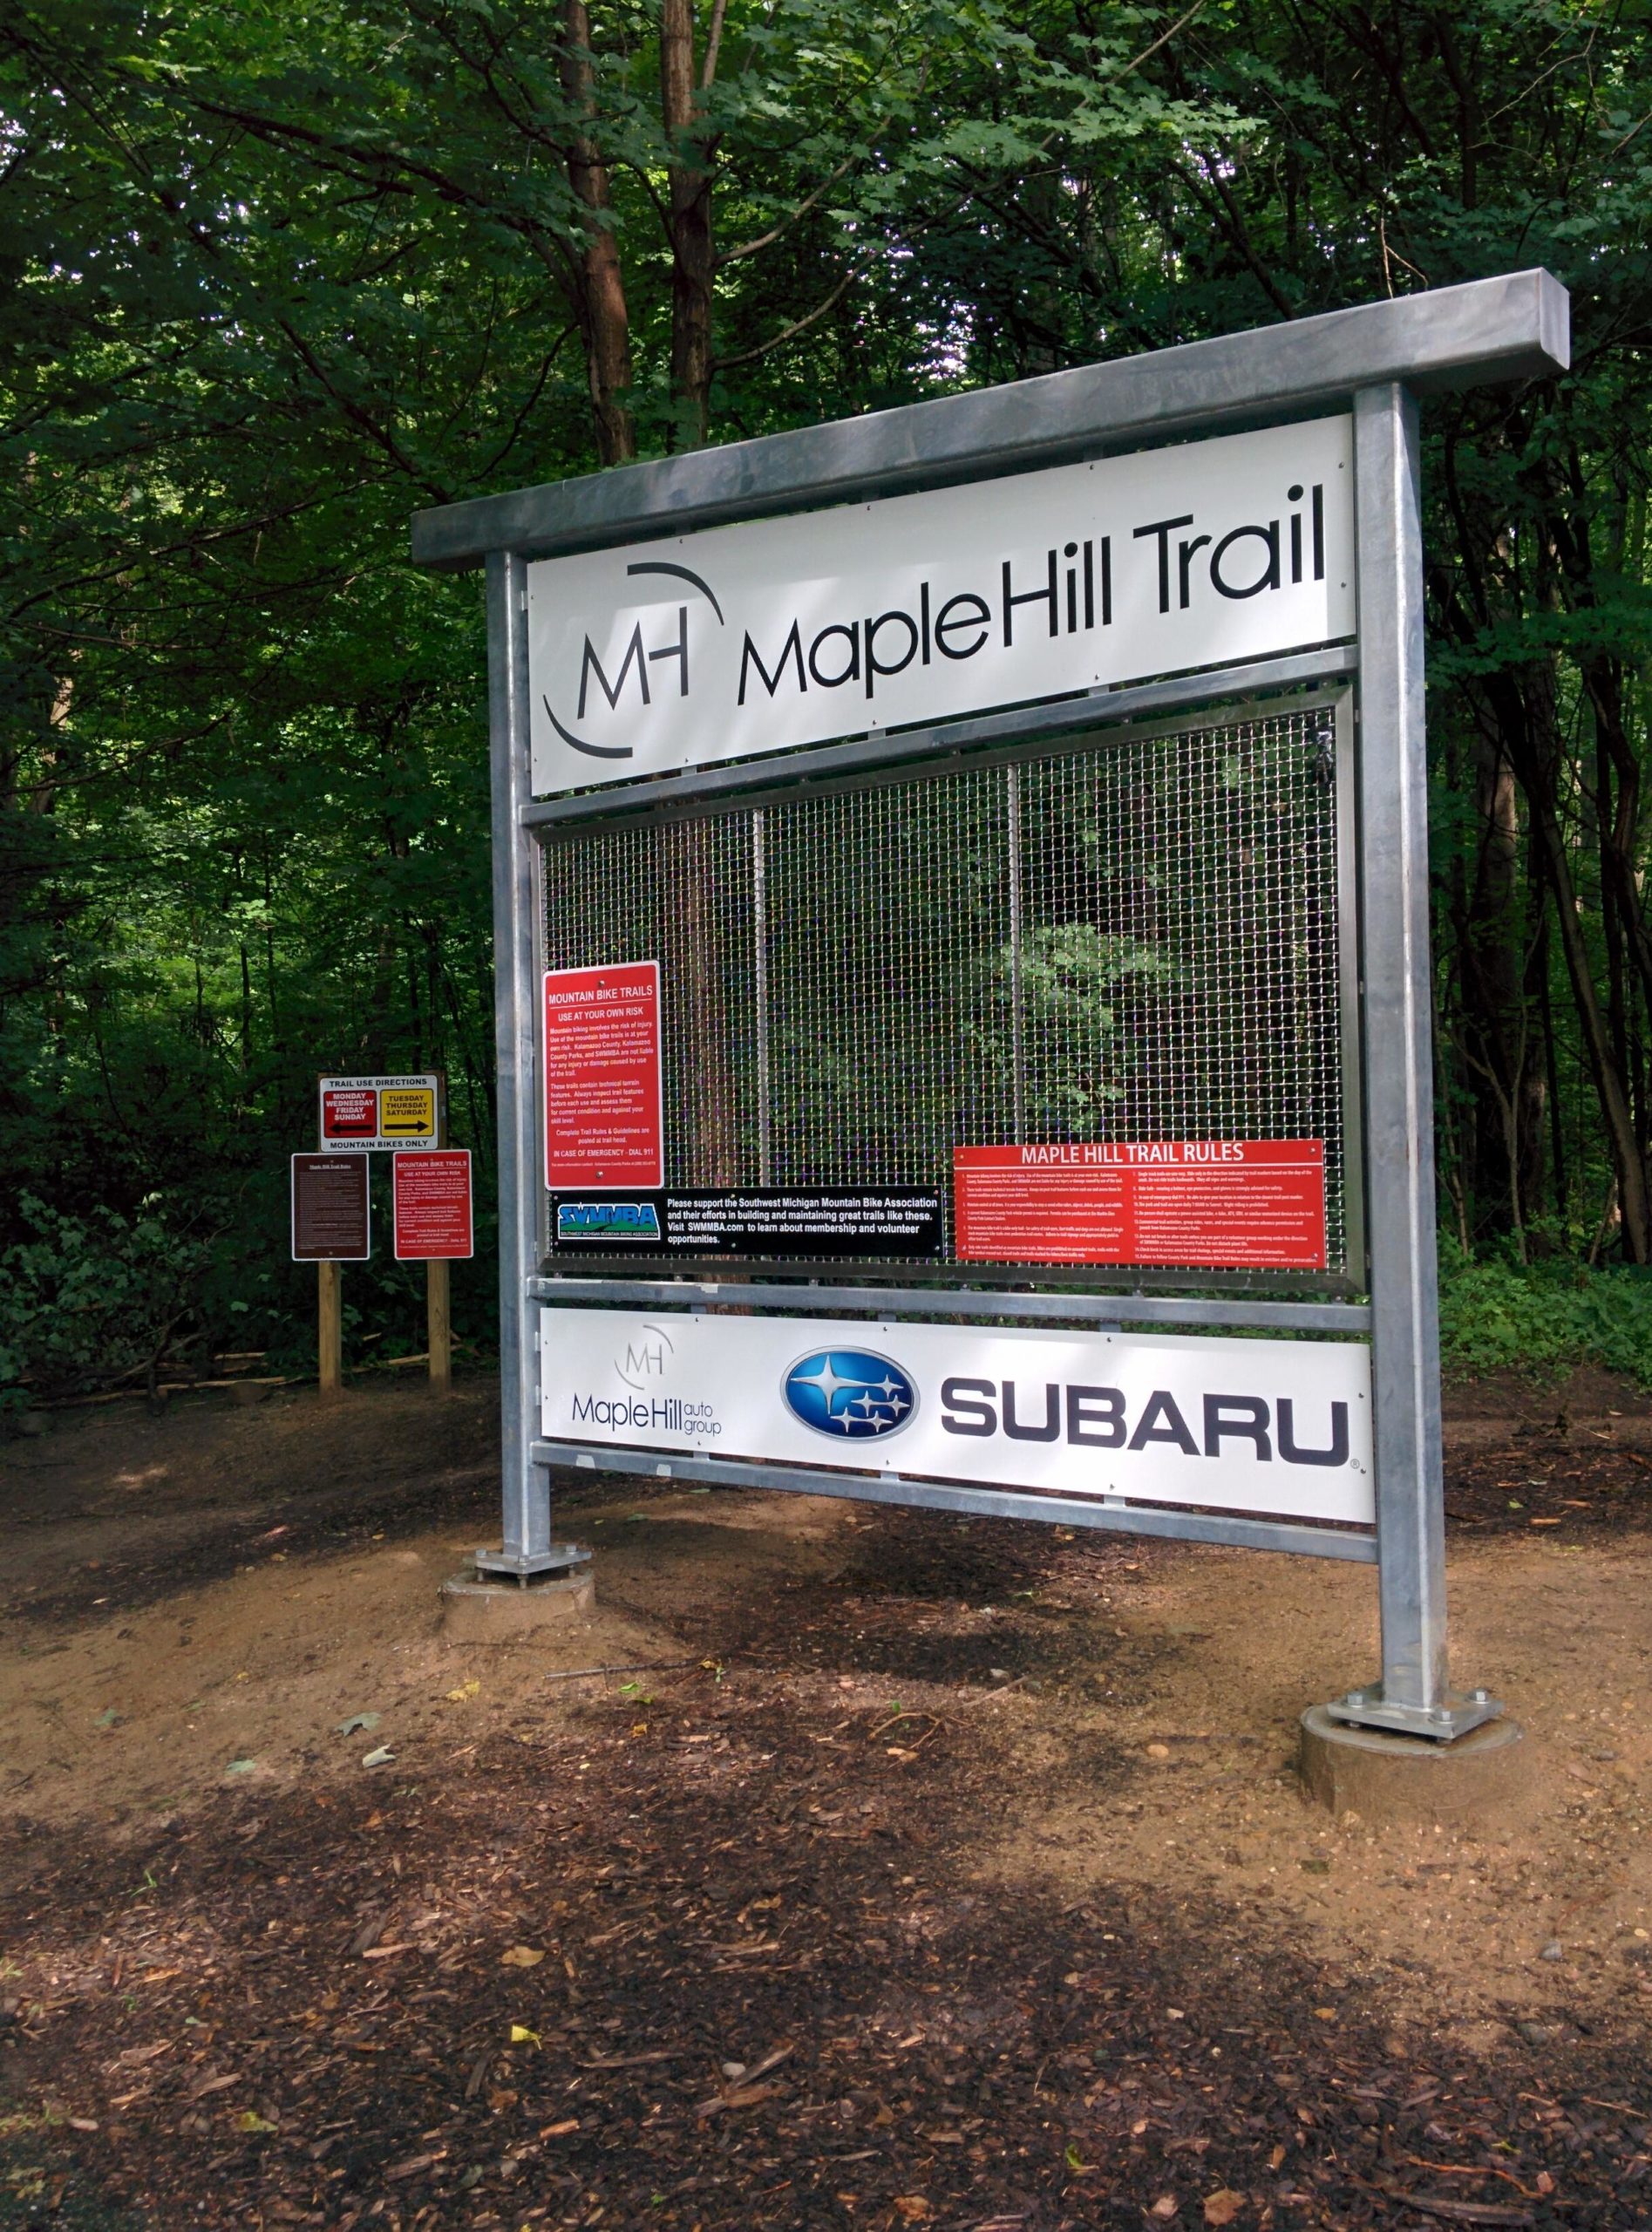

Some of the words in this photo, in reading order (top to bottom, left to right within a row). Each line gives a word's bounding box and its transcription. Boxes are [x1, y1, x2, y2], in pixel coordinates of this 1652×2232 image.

[1133, 484, 1324, 614] Trail
[578, 607, 688, 719] MH
[549, 991, 594, 1004] MOUNTAIN
[596, 989, 617, 1000] BIKE
[620, 985, 652, 997] TRAILS
[558, 1013, 572, 1022] USE
[584, 1011, 605, 1019] YOUR
[607, 1009, 624, 1017] OWN
[626, 1007, 643, 1016] RISK
[1021, 1147, 1079, 1164] MAPLE
[1084, 1146, 1122, 1162] HILL
[1125, 1144, 1178, 1162] TRAIL
[1183, 1143, 1244, 1161] RULES
[668, 1199, 692, 1208] Please
[693, 1199, 723, 1209] support
[738, 1198, 780, 1208] Southwest
[783, 1198, 819, 1208] Michigan
[821, 1198, 860, 1208] Mountain
[863, 1198, 882, 1207] Bike
[884, 1198, 937, 1208] Association
[668, 1211, 682, 1220] and
[683, 1210, 700, 1220] their
[702, 1210, 727, 1220] efforts
[729, 1211, 736, 1220] in
[738, 1210, 769, 1221] building
[772, 1211, 786, 1220] and
[788, 1210, 837, 1222] maintaining
[839, 1211, 860, 1222] great
[863, 1210, 884, 1220] trails
[887, 1210, 902, 1220] like
[905, 1210, 933, 1221] these.
[668, 1222, 684, 1231] Visit
[688, 1222, 744, 1232] SWMMBA.com
[747, 1223, 756, 1232] to
[758, 1223, 778, 1232] learn
[779, 1223, 804, 1232] about
[805, 1223, 857, 1235] membership
[859, 1224, 875, 1233] and
[877, 1224, 919, 1234] volunteer
[668, 1235, 720, 1245] opportunities.
[626, 1343, 664, 1375] MH
[684, 1402, 713, 1417] auto
[684, 1419, 722, 1437] group
[942, 1377, 1349, 1466] SUBARU
